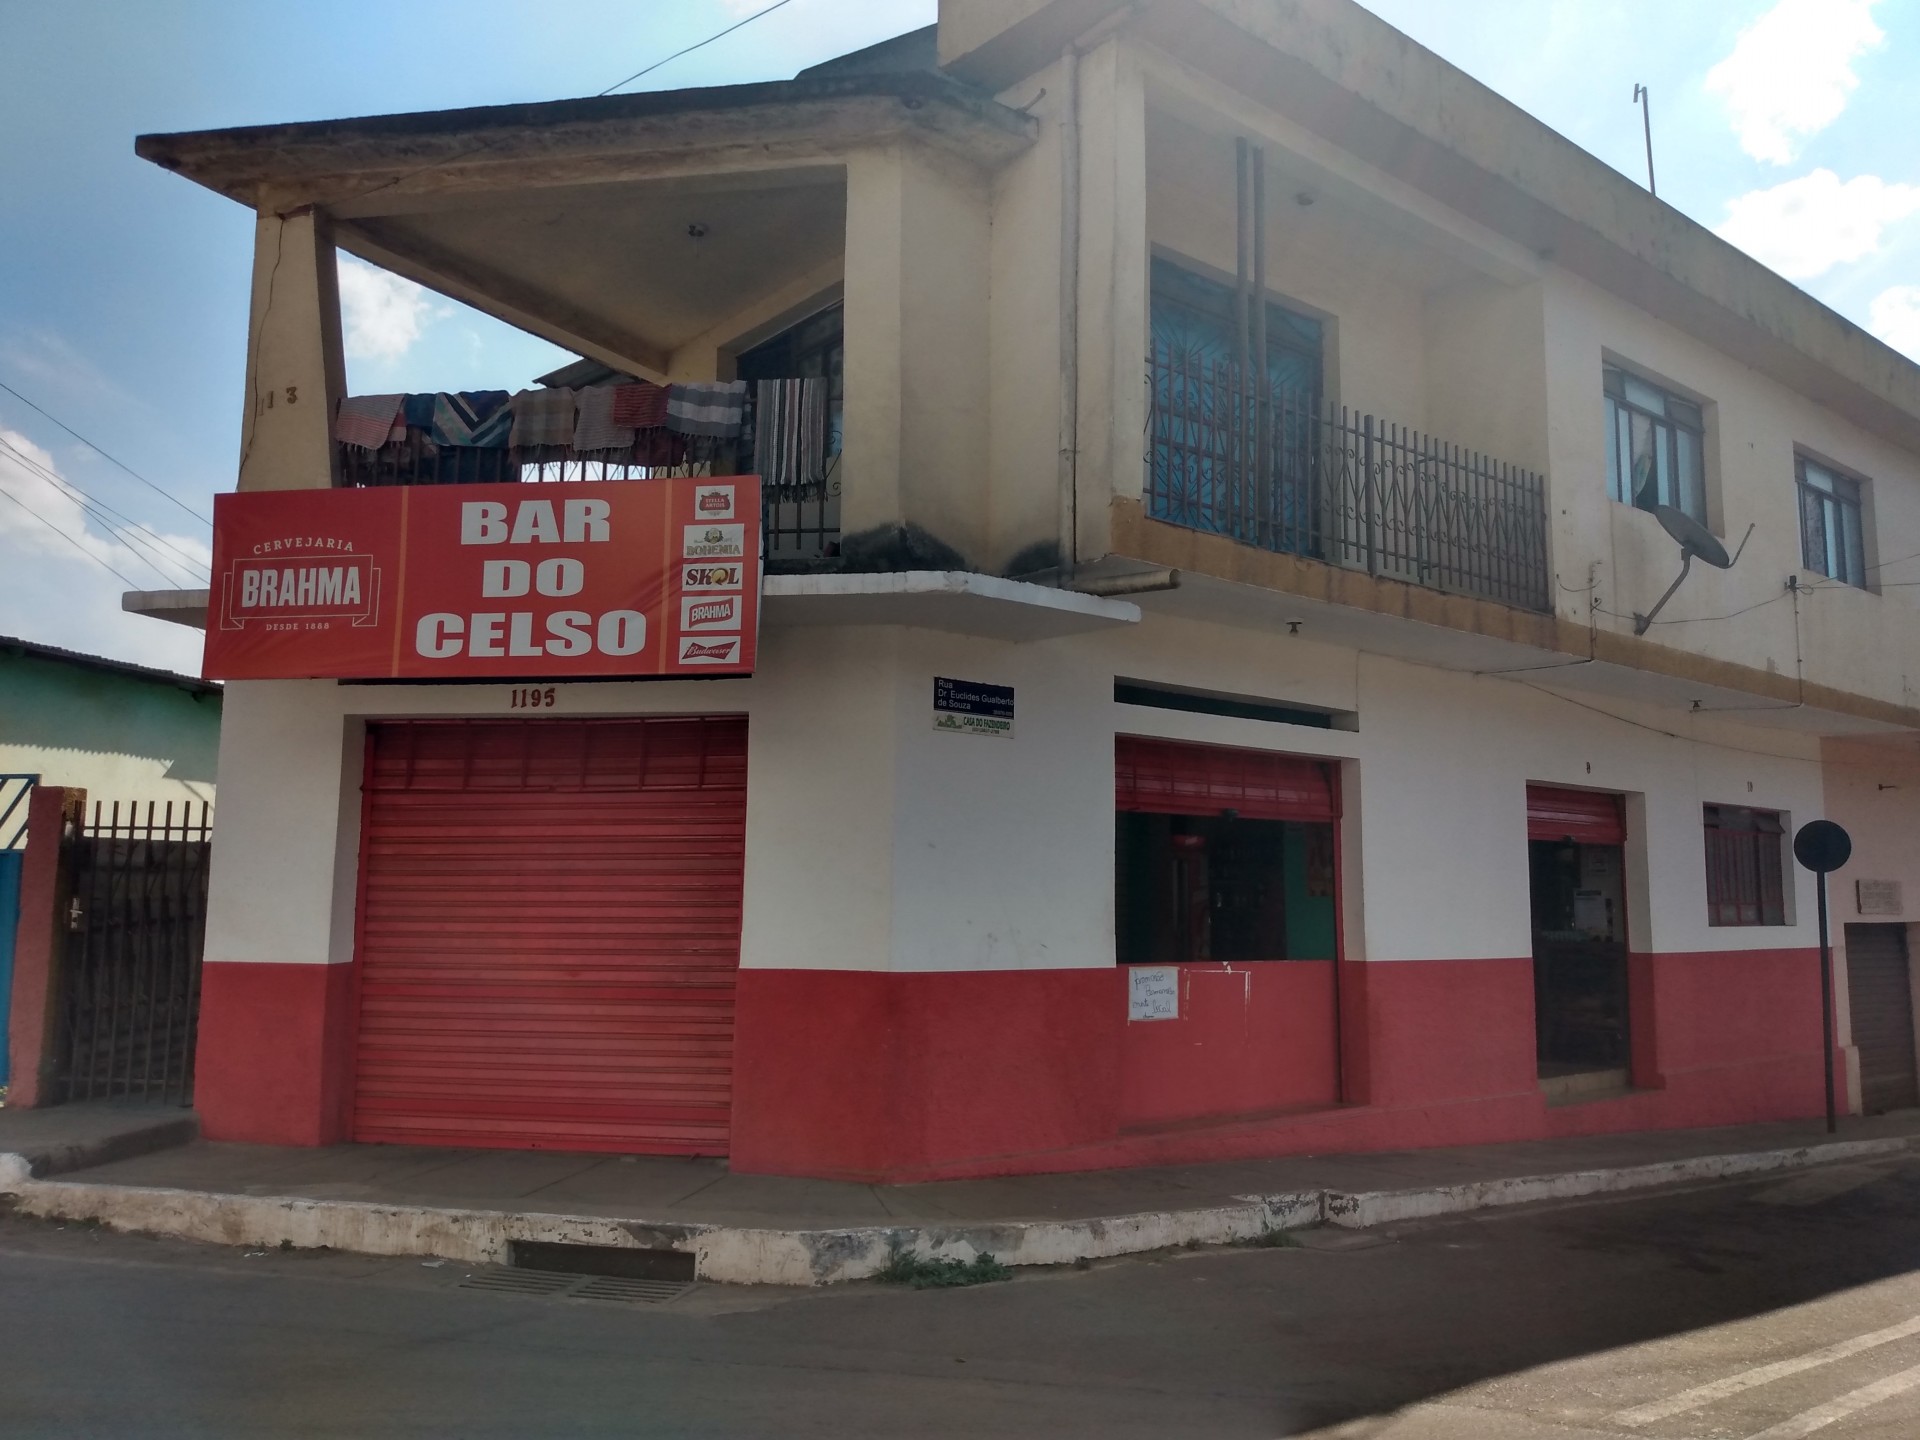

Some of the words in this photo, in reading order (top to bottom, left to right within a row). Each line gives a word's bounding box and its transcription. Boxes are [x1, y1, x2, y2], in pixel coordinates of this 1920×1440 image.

[460, 499, 611, 545] BAR
[253, 537, 353, 555] CERVEJARIA
[686, 545, 740, 556] BOHEMIA
[482, 557, 585, 598] DO
[686, 568, 739, 586] SKOL
[241, 566, 361, 608] BRAHMA
[692, 604, 730, 622] BRAHMA
[265, 623, 299, 632] DESDE
[305, 622, 330, 631] 1888
[415, 609, 647, 659] CELSO
[687, 645, 731, 656] Budweiser
[939, 680, 953, 688] Rua
[511, 687, 556, 708] 1195
[938, 689, 947, 697] Dr
[951, 691, 979, 702] Euclides
[981, 694, 1014, 706] Gualberto
[949, 701, 971, 710] Souza
